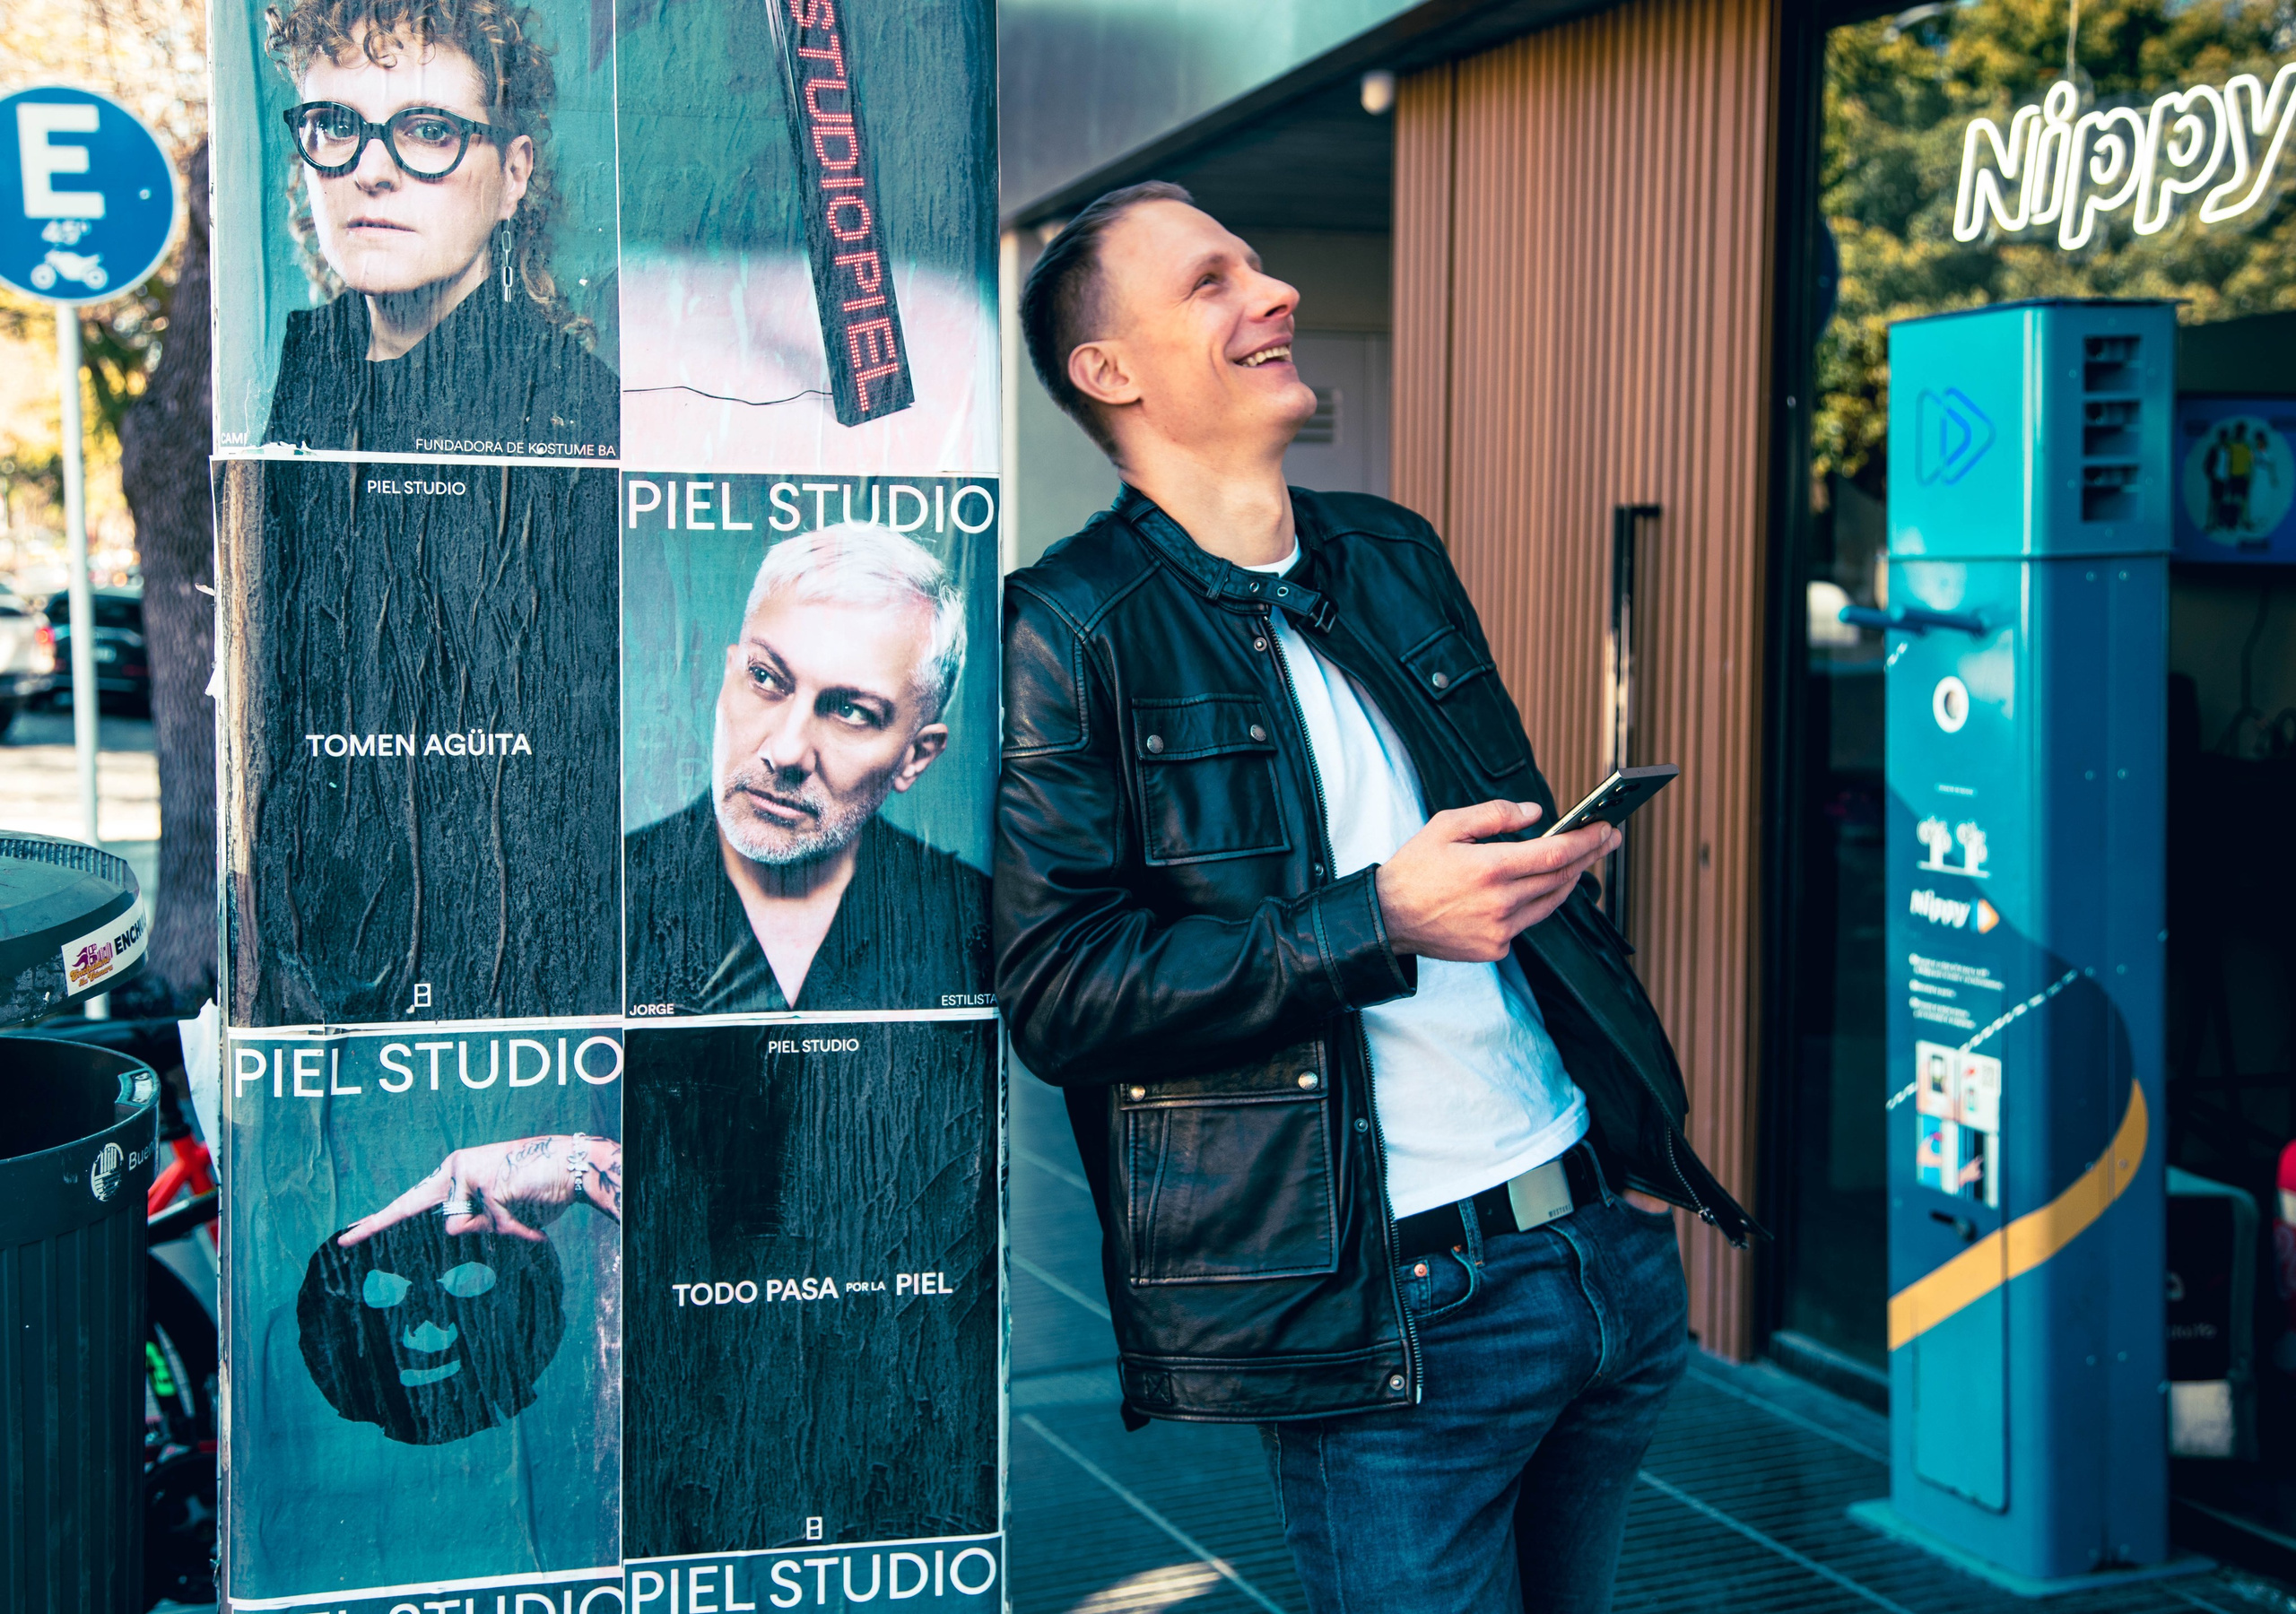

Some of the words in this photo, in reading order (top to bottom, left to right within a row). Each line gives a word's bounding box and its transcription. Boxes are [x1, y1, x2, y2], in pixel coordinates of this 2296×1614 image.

[16, 102, 105, 219] E
[1952, 62, 2296, 250] Nippy
[415, 438, 503, 453] FUNDADORA
[507, 442, 525, 454] DE
[528, 442, 595, 456] KOSTUME
[598, 445, 616, 456] BA
[367, 480, 401, 495] PIEL
[404, 482, 466, 496] STUDIO
[628, 480, 753, 531] PIEL
[768, 482, 995, 534] STUDIO
[305, 733, 415, 758] TOMEN
[423, 728, 533, 757] AGÜITA
[629, 1002, 674, 1016] JORGE
[941, 993, 997, 1006] ESTILISTA
[768, 1040, 799, 1054] PIEL
[802, 1038, 860, 1053] STUDIO
[235, 1047, 362, 1098] PIEL
[378, 1036, 624, 1093] STUDIO
[672, 1280, 758, 1307] TODO
[766, 1277, 839, 1302] PASA
[846, 1281, 869, 1292] POR
[871, 1281, 886, 1291] LA
[896, 1271, 953, 1296] PIEL
[631, 1565, 756, 1614] PIEL
[769, 1547, 997, 1609] STUDIO
